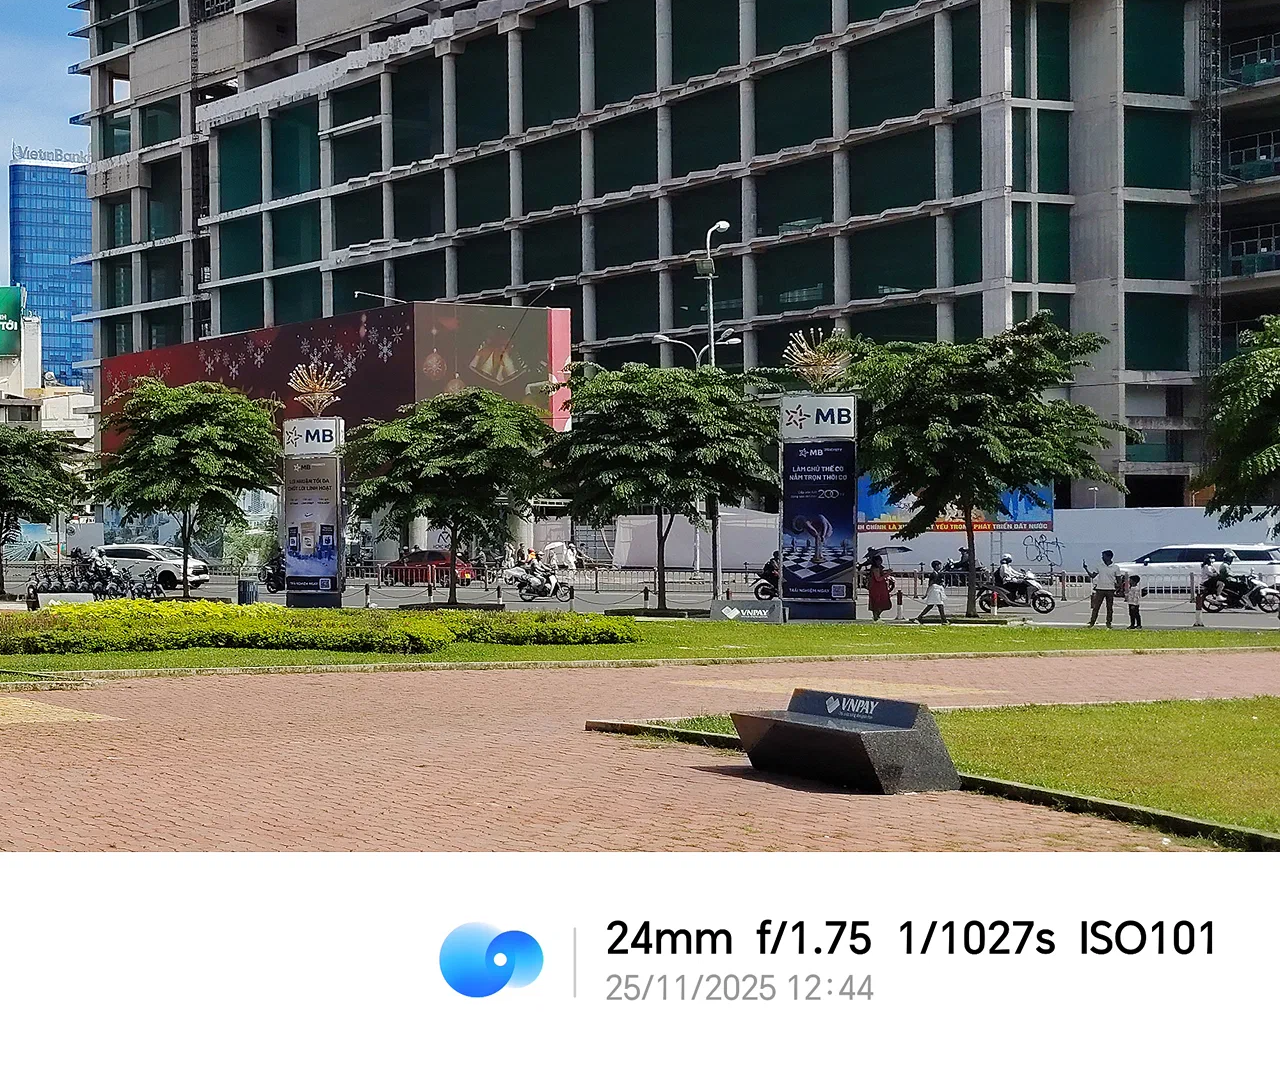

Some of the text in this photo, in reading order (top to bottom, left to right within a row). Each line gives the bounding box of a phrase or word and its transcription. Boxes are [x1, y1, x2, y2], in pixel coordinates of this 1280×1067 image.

[17, 145, 89, 163] VietinBank
[815, 407, 852, 425] MB
[305, 429, 334, 443] MB
[809, 448, 824, 456] MB
[818, 489, 840, 499] 200
[841, 697, 880, 715] VNPAY
